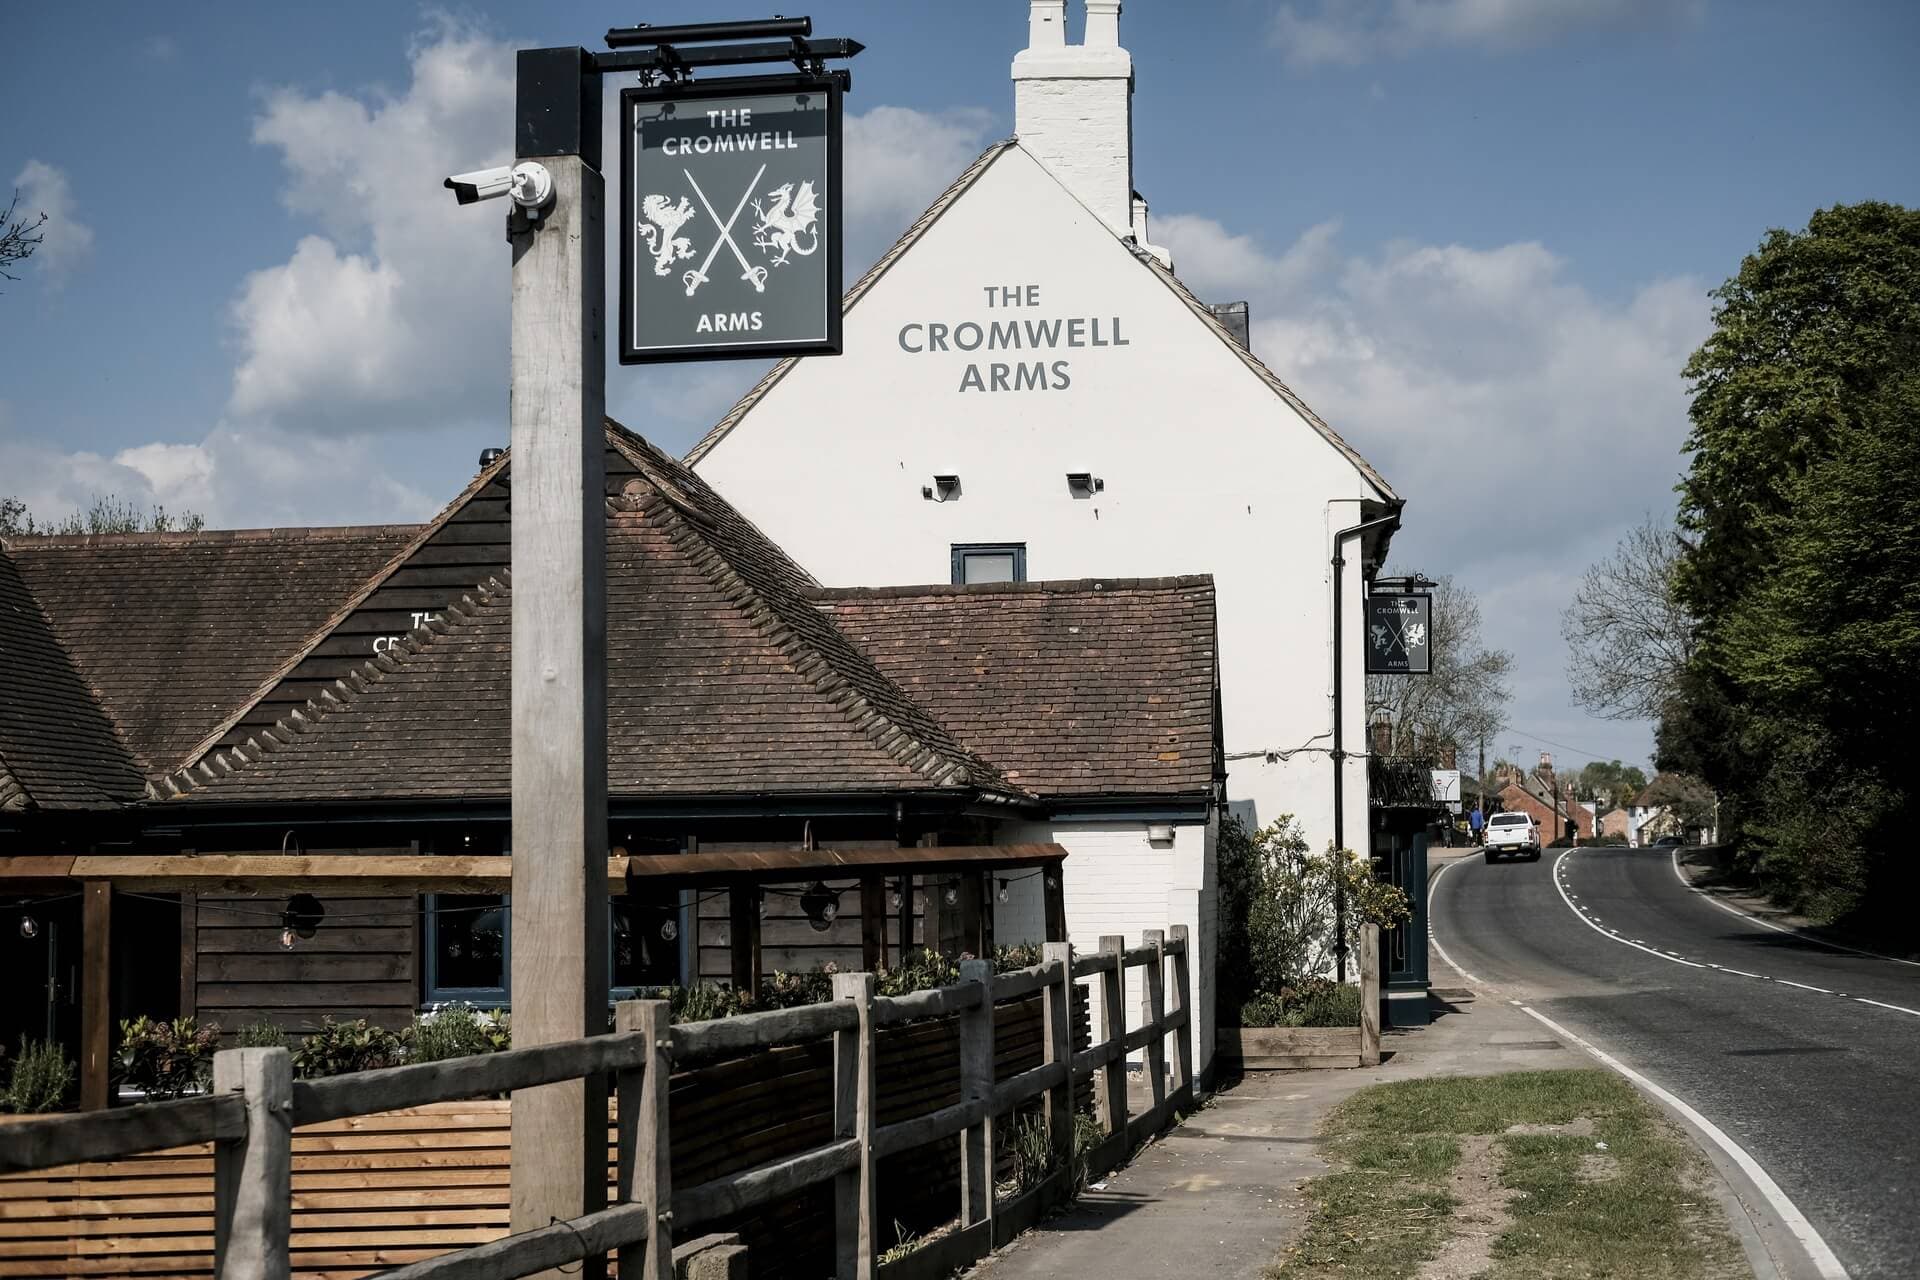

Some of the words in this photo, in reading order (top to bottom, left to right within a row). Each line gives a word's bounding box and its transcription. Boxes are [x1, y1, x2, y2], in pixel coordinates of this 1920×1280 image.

[706, 108, 752, 128] THE
[662, 131, 798, 156] CROMWELL
[984, 285, 1040, 308] THE
[696, 311, 763, 333] ARMS
[899, 317, 1130, 353] CROMWELL
[958, 360, 1071, 393] ARMS
